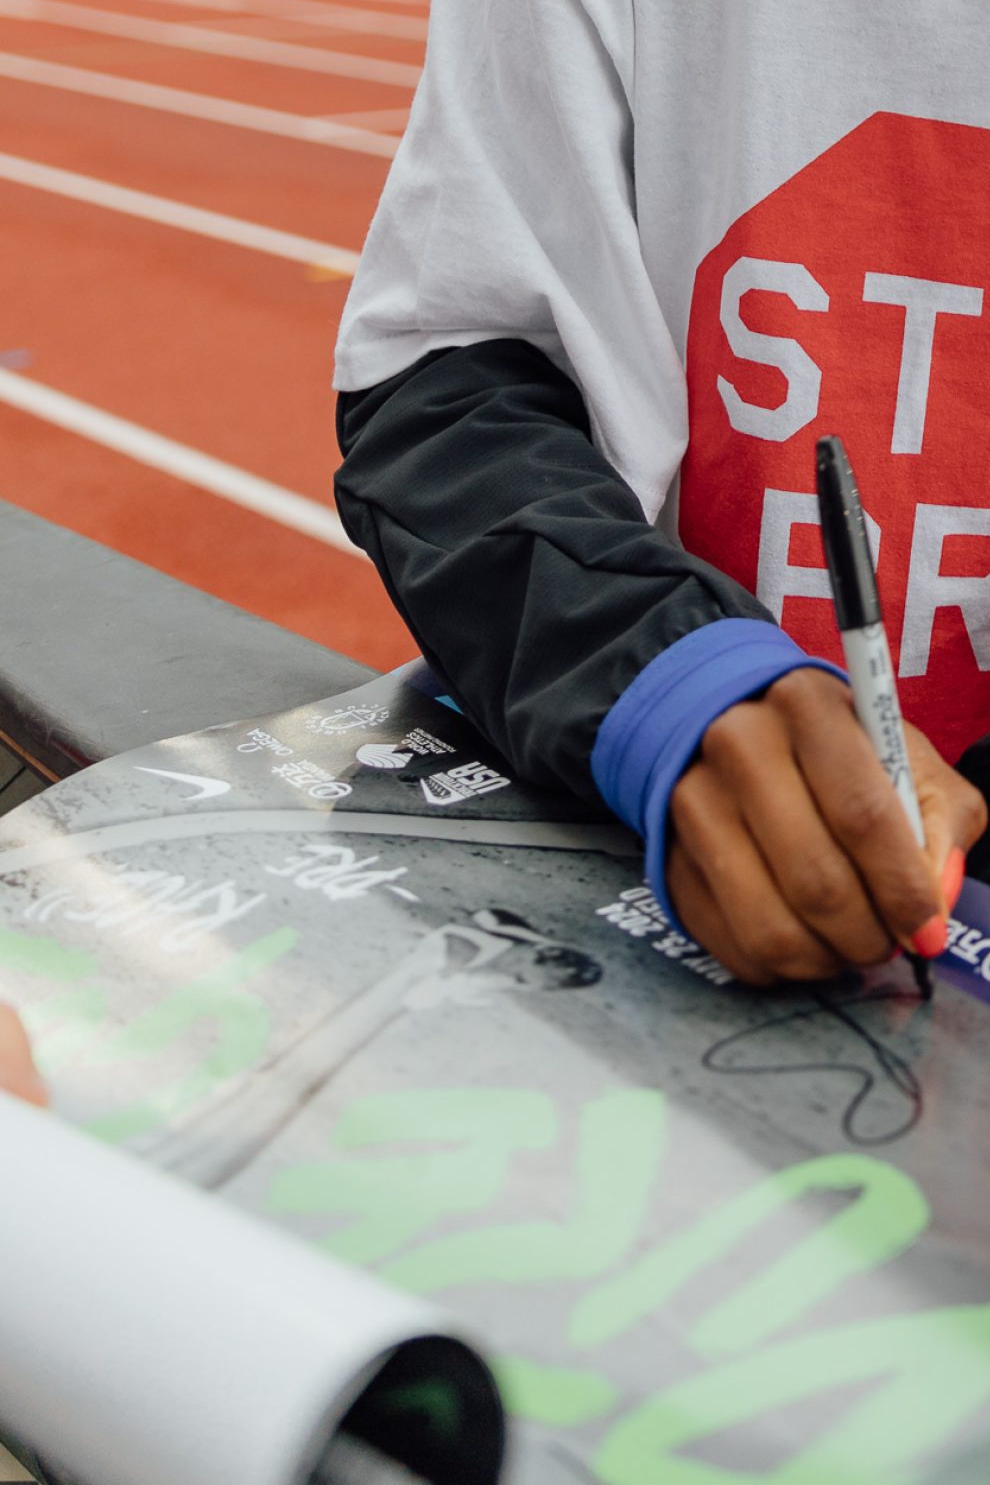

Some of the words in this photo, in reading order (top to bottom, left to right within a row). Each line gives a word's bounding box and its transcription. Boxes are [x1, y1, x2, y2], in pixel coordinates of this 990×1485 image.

[247, 728, 294, 756] OMEGA
[401, 738, 430, 756] WORLD
[873, 692, 909, 788] Sharpie
[447, 761, 512, 795] USA
[594, 902, 665, 937] 2024
